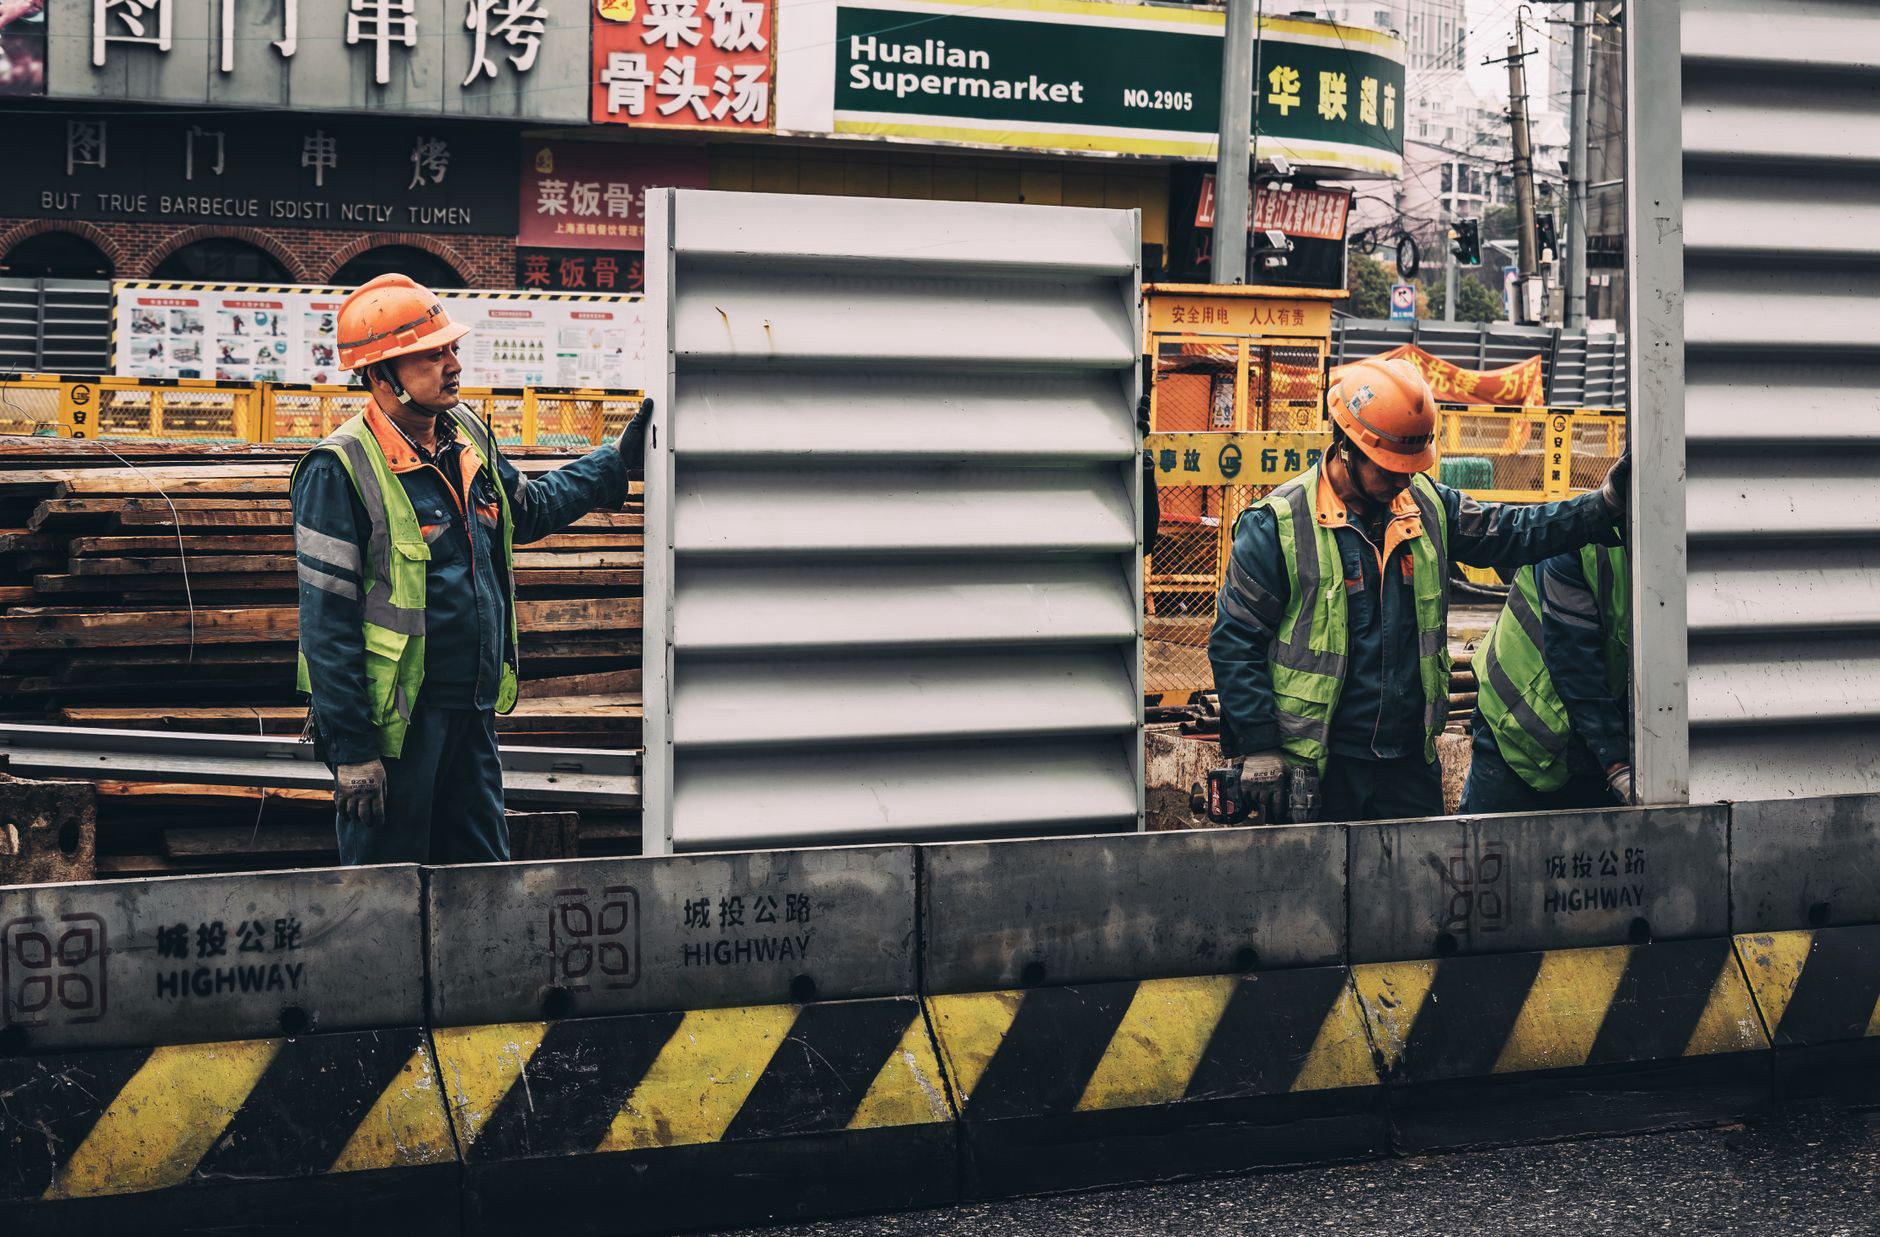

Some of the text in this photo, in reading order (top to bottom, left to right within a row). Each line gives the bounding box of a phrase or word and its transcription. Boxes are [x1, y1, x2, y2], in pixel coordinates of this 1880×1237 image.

[640, 0, 768, 51] 菜饭
[850, 34, 991, 70] Hualian
[601, 52, 768, 122] 骨头汤
[849, 63, 1084, 104] Supermarket
[1123, 88, 1193, 111] NO.2905
[1267, 64, 1396, 131] 华联超市
[66, 119, 451, 190] 图门串烤
[41, 191, 82, 210] BUT
[97, 193, 148, 213] TRUE
[160, 195, 259, 217] BARBECUE
[408, 205, 471, 225] TUMEN
[1172, 304, 1305, 327] 安全用电 人人有责
[683, 893, 811, 929] 城投公路
[1543, 884, 1644, 913] HIGHWAY
[683, 935, 811, 967] HIGHWAY
[156, 962, 303, 998] HIGHWAY
